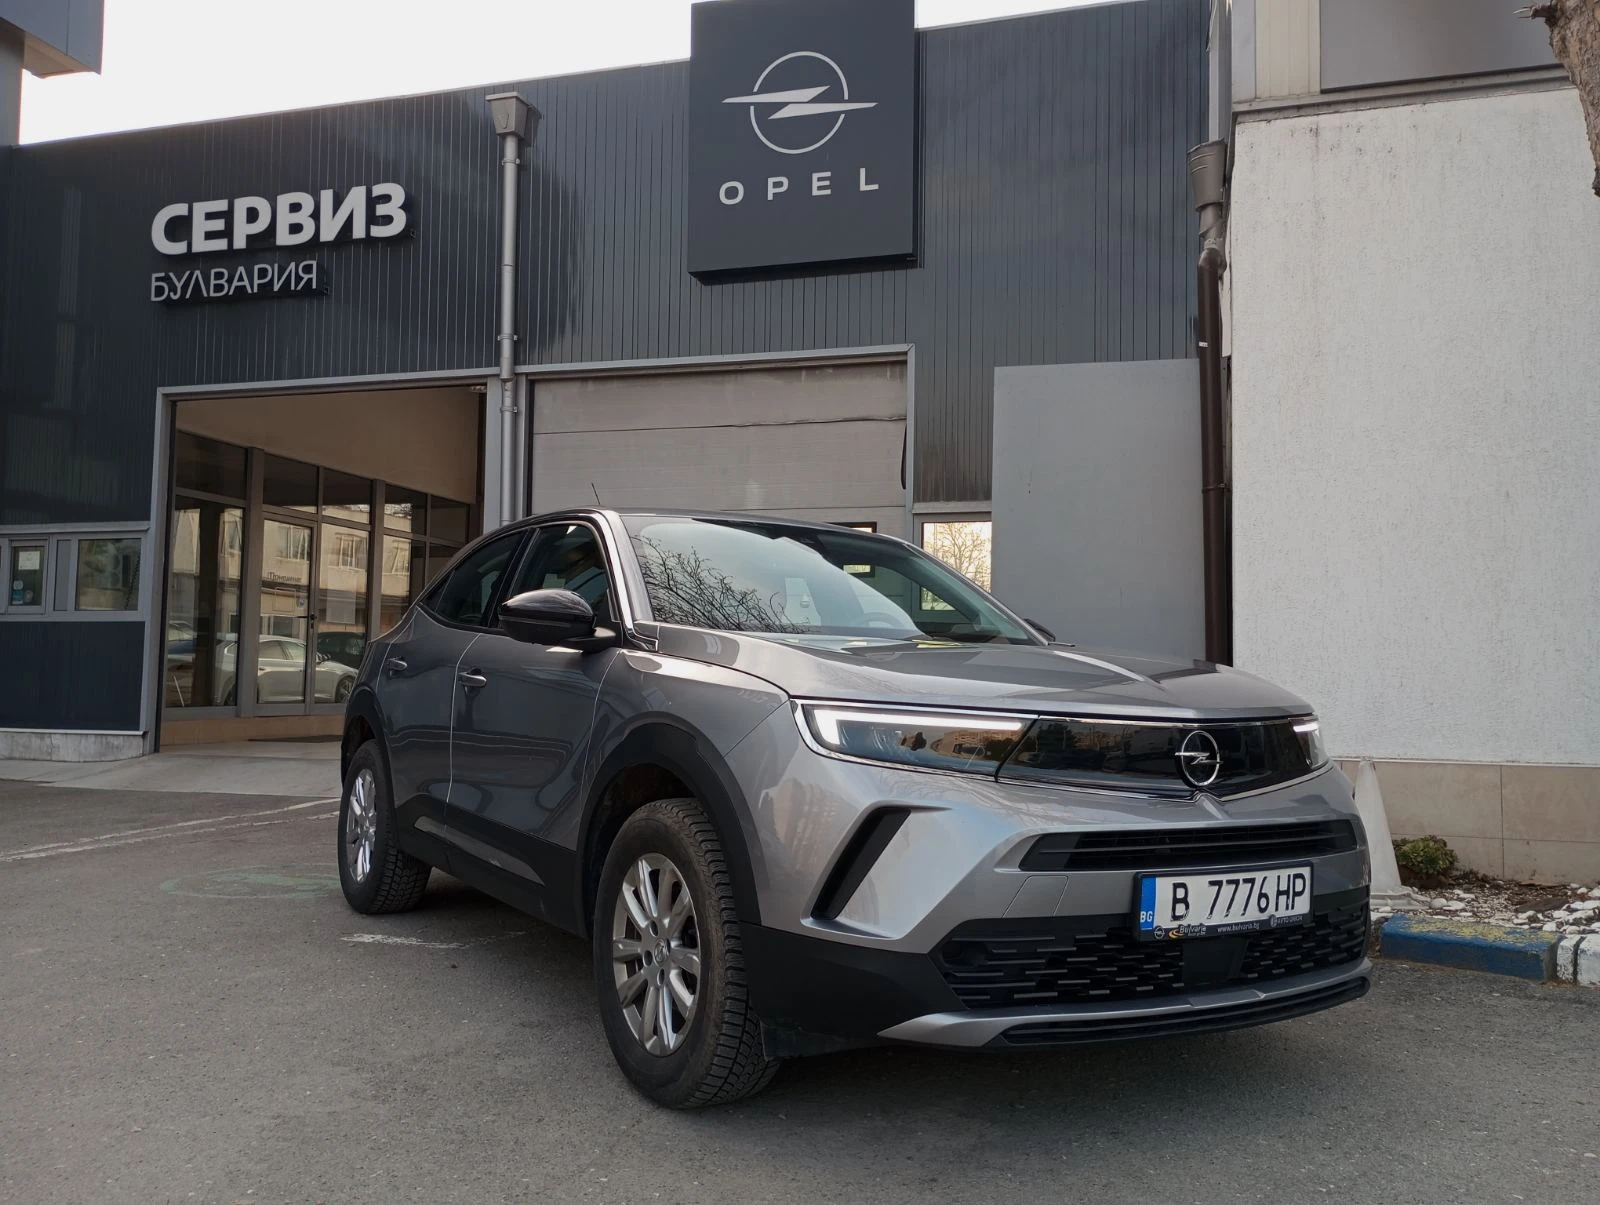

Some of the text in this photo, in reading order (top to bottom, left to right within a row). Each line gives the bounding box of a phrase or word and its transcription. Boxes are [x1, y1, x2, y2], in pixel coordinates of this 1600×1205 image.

[719, 168, 879, 205] OPEL
[151, 182, 407, 255] СЕРВИЗ
[151, 260, 318, 301] БУЛВАРИЯ
[1140, 911, 1153, 922] BG
[1170, 873, 1306, 922] B 7776 HP
